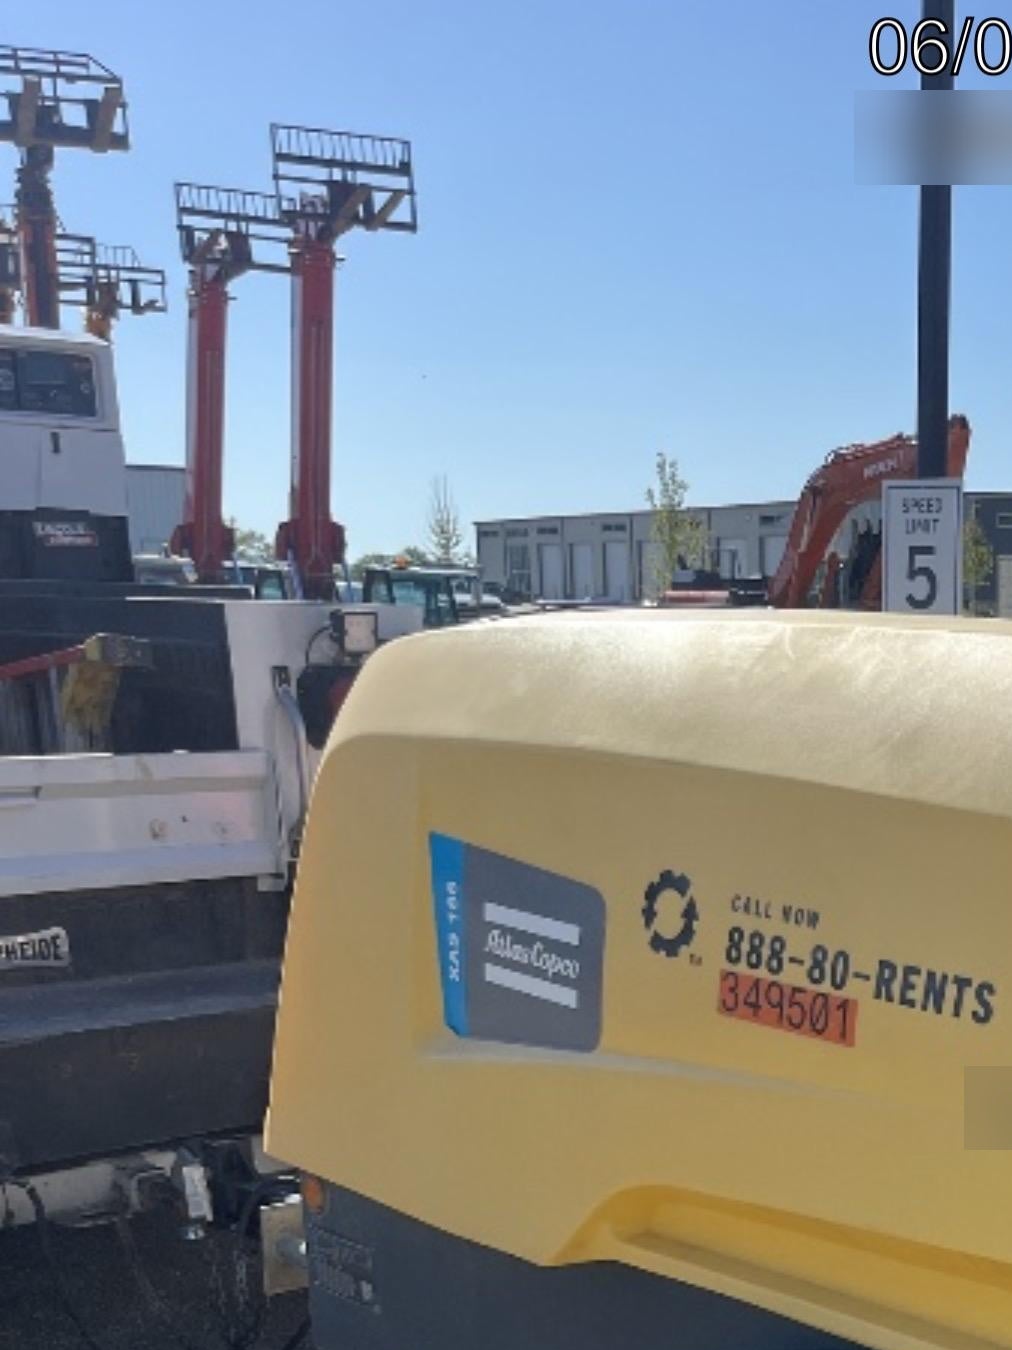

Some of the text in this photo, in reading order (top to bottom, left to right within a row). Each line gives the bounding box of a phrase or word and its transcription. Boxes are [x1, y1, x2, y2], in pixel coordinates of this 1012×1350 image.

[902, 497, 943, 514] SPEED
[905, 518, 939, 535] LIMIT
[905, 545, 937, 610] 5
[731, 893, 820, 930] CALL NOW
[725, 925, 996, 1025] 888-80-RENTS
[720, 970, 849, 1042] 349501
